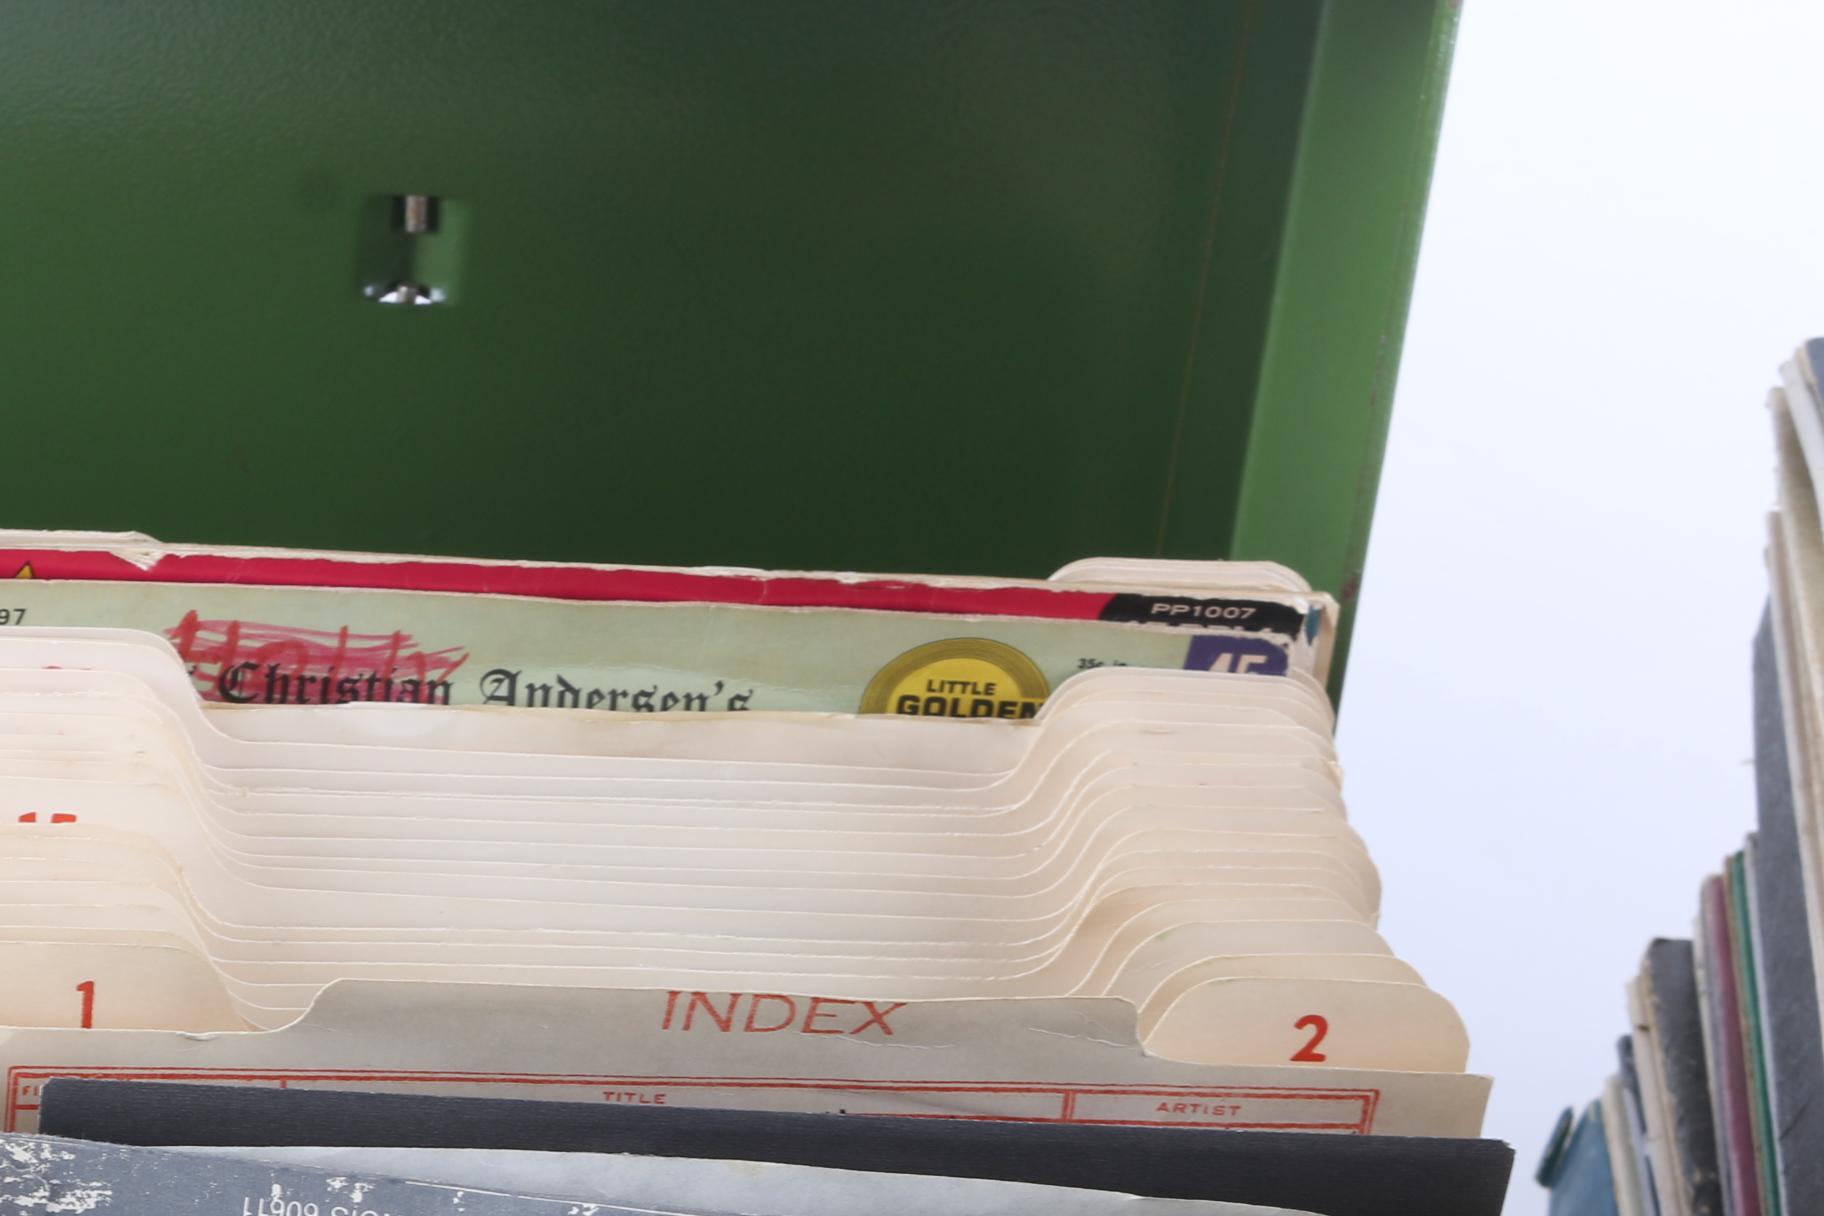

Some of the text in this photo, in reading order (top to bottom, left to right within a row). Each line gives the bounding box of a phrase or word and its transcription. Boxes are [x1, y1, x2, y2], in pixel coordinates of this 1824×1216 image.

[1150, 603, 1256, 619] PP1007
[218, 661, 754, 712] Christian Andersen's
[927, 679, 996, 696] LITTLE
[896, 694, 1044, 719] GOLDEN
[76, 980, 94, 1028] 1
[662, 990, 907, 1035] INDEX
[1289, 1014, 1329, 1062] 2
[602, 1091, 666, 1104] TITLE
[1155, 1102, 1243, 1117] ARTIST
